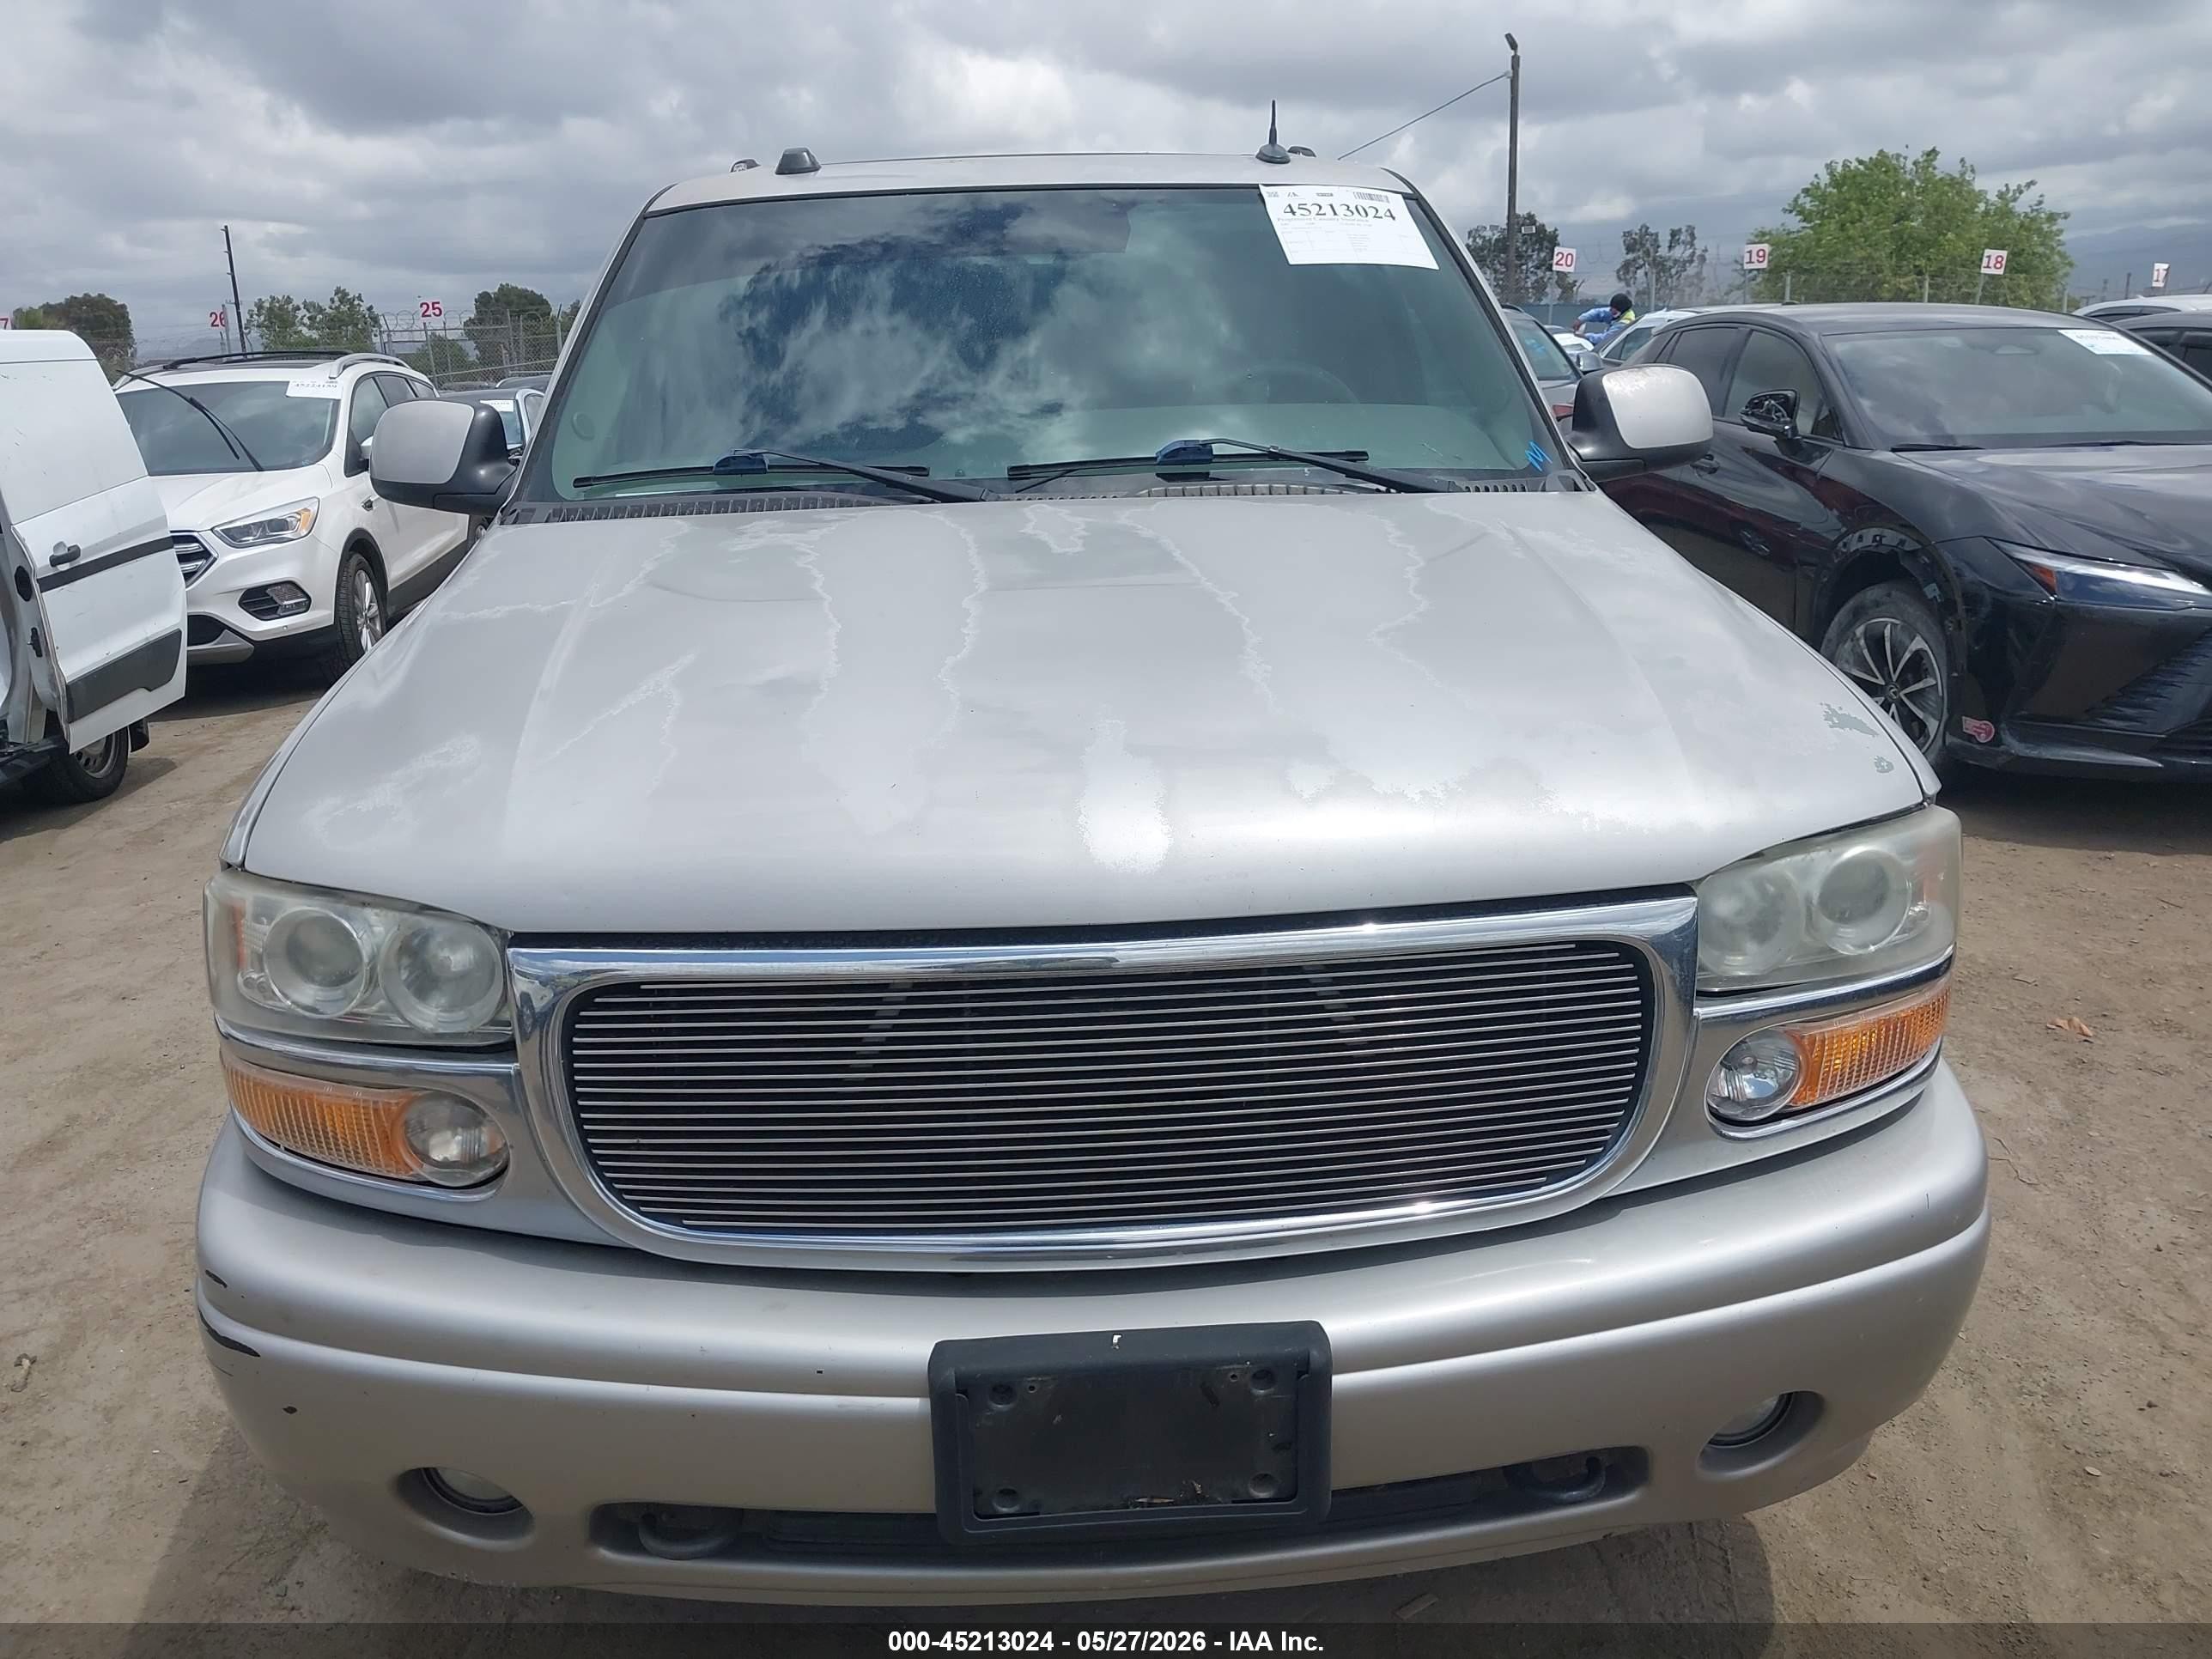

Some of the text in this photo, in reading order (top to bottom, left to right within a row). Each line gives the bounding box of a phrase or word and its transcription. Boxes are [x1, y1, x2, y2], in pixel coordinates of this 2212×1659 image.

[1283, 202, 1395, 221] 45213024
[1555, 252, 1574, 267] 20
[1745, 248, 1766, 264] 19
[1983, 254, 2004, 270] 18
[419, 301, 442, 318] 25
